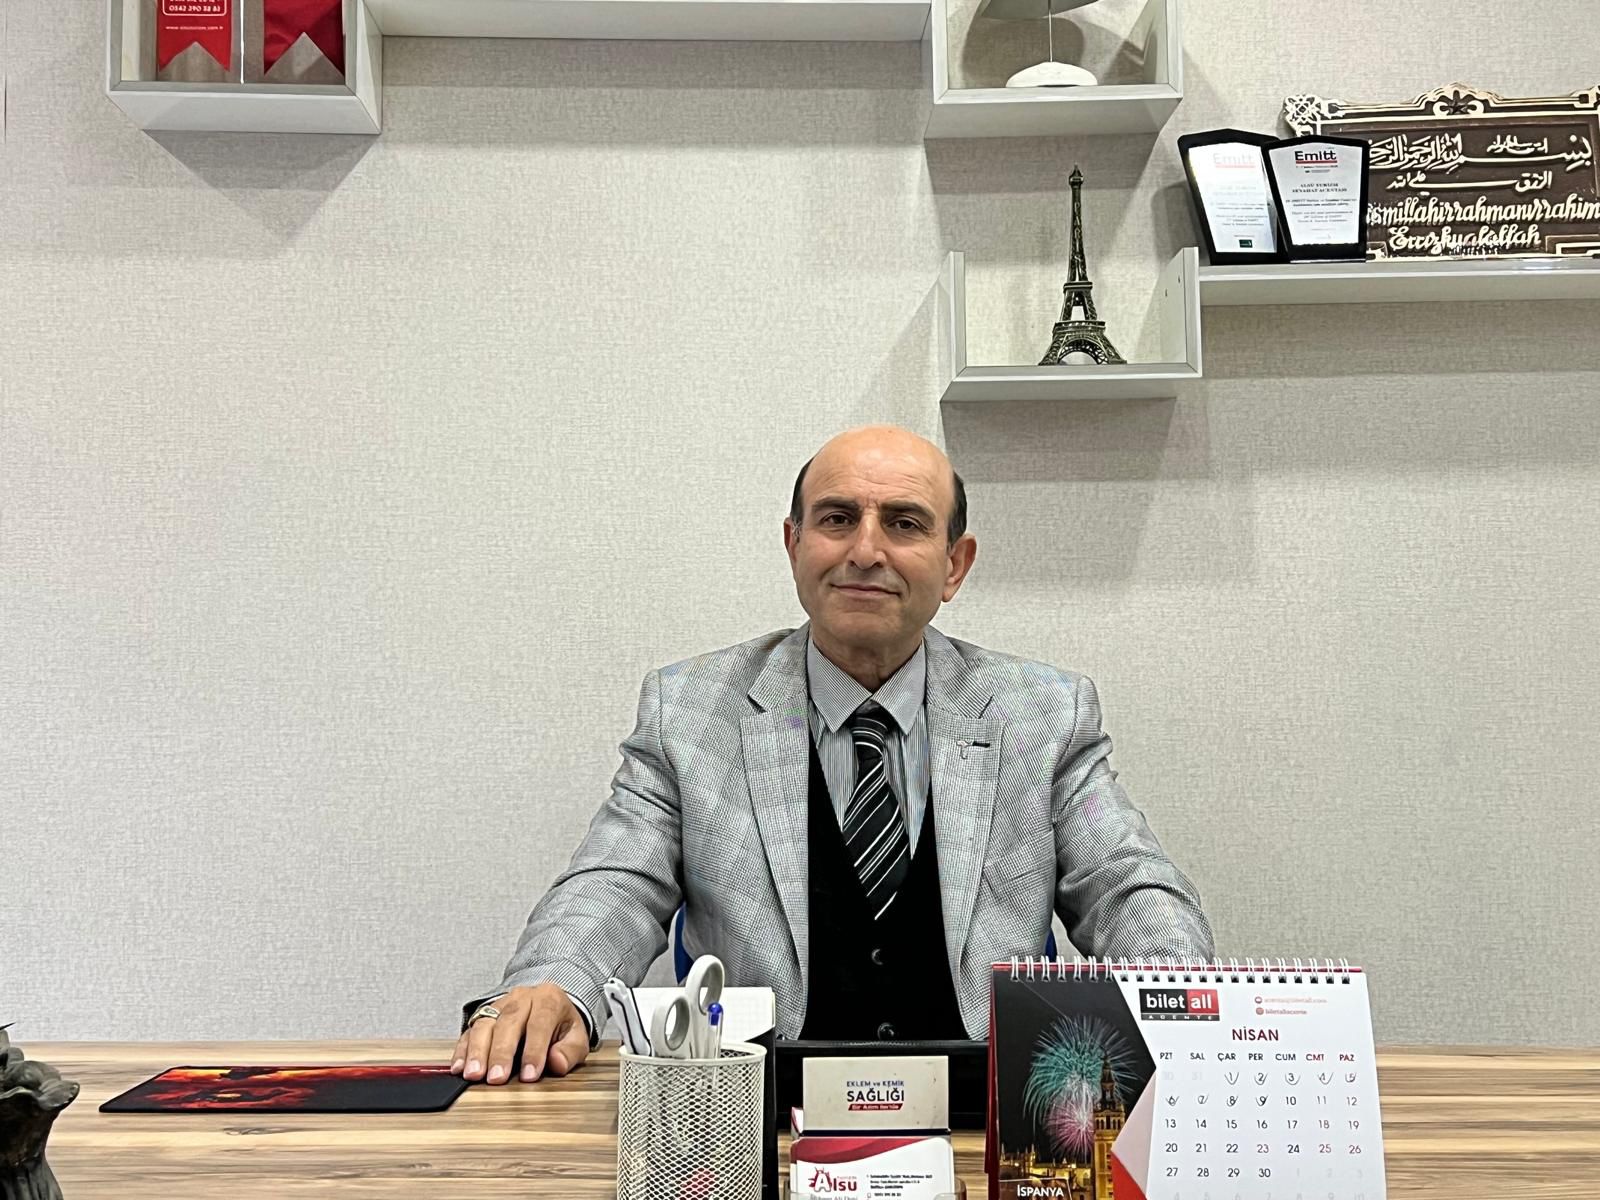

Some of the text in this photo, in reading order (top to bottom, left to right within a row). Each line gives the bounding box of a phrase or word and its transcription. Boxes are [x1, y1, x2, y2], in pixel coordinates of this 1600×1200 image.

[1294, 150, 1337, 161] Emitt
[1146, 993, 1213, 1009] bilet all
[1231, 1026, 1280, 1042] NİSAN
[1159, 1052, 1356, 1062] PZT SAL ÇAR PER CUM CMT PAZ
[846, 1088, 905, 1102] SAĞLIĞI
[1285, 1095, 1297, 1106] 10
[1316, 1095, 1327, 1105] 11
[1346, 1096, 1358, 1107] 12
[1164, 1119, 1360, 1130] 13 14 15 16 17 18 19
[1164, 1143, 1362, 1154] 20 21 22 23 24 25 26
[1166, 1167, 1179, 1177] 27
[1196, 1167, 1210, 1177] 28
[1227, 1167, 1241, 1178] 29
[1258, 1168, 1272, 1178] 30
[812, 1168, 858, 1193] Alsu
